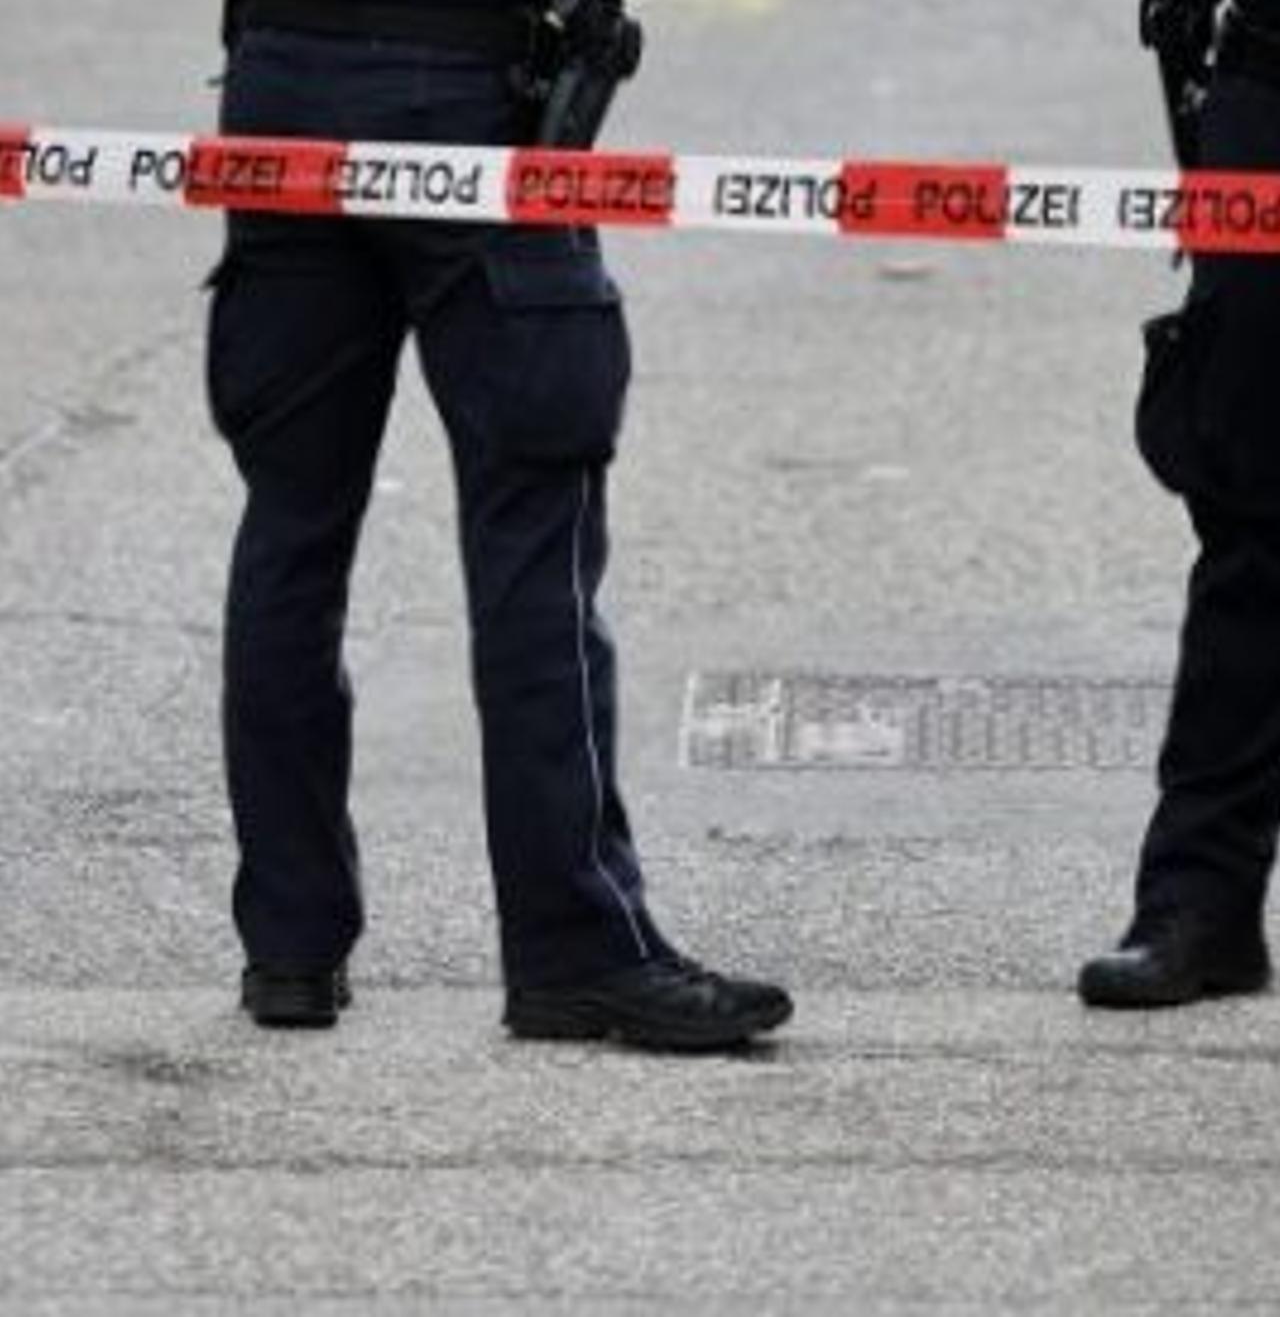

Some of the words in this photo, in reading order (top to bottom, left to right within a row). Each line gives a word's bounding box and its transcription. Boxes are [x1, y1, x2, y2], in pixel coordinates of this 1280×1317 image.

[130, 149, 287, 195] POLIZEI
[325, 157, 482, 205] POLIZEI
[516, 165, 677, 212] POLIZEI
[713, 173, 877, 222] POLIZEI
[914, 181, 1081, 228] POLIZEI
